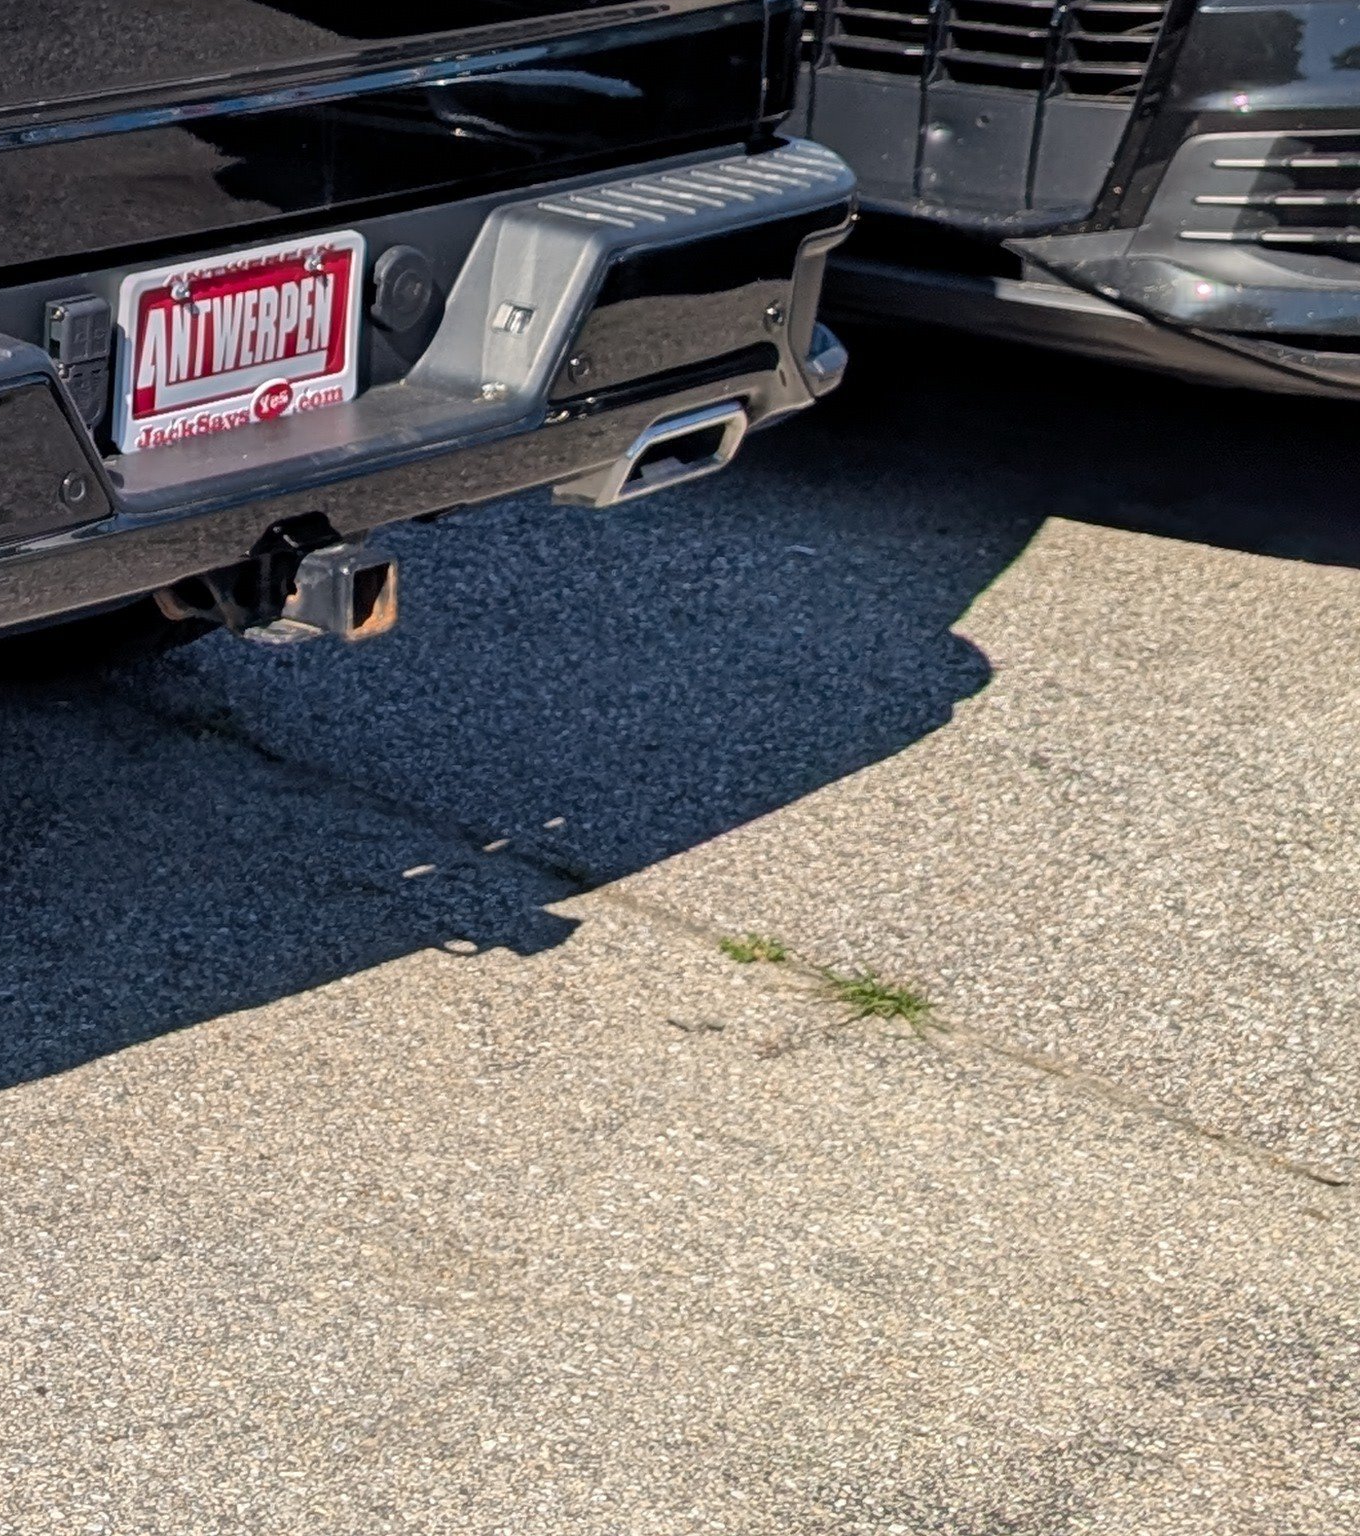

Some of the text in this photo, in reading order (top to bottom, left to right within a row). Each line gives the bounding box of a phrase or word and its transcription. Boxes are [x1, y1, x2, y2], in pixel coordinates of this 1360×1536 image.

[137, 273, 335, 410] ANTWERPEN
[135, 409, 252, 449] JackSays
[259, 390, 289, 412] Yes
